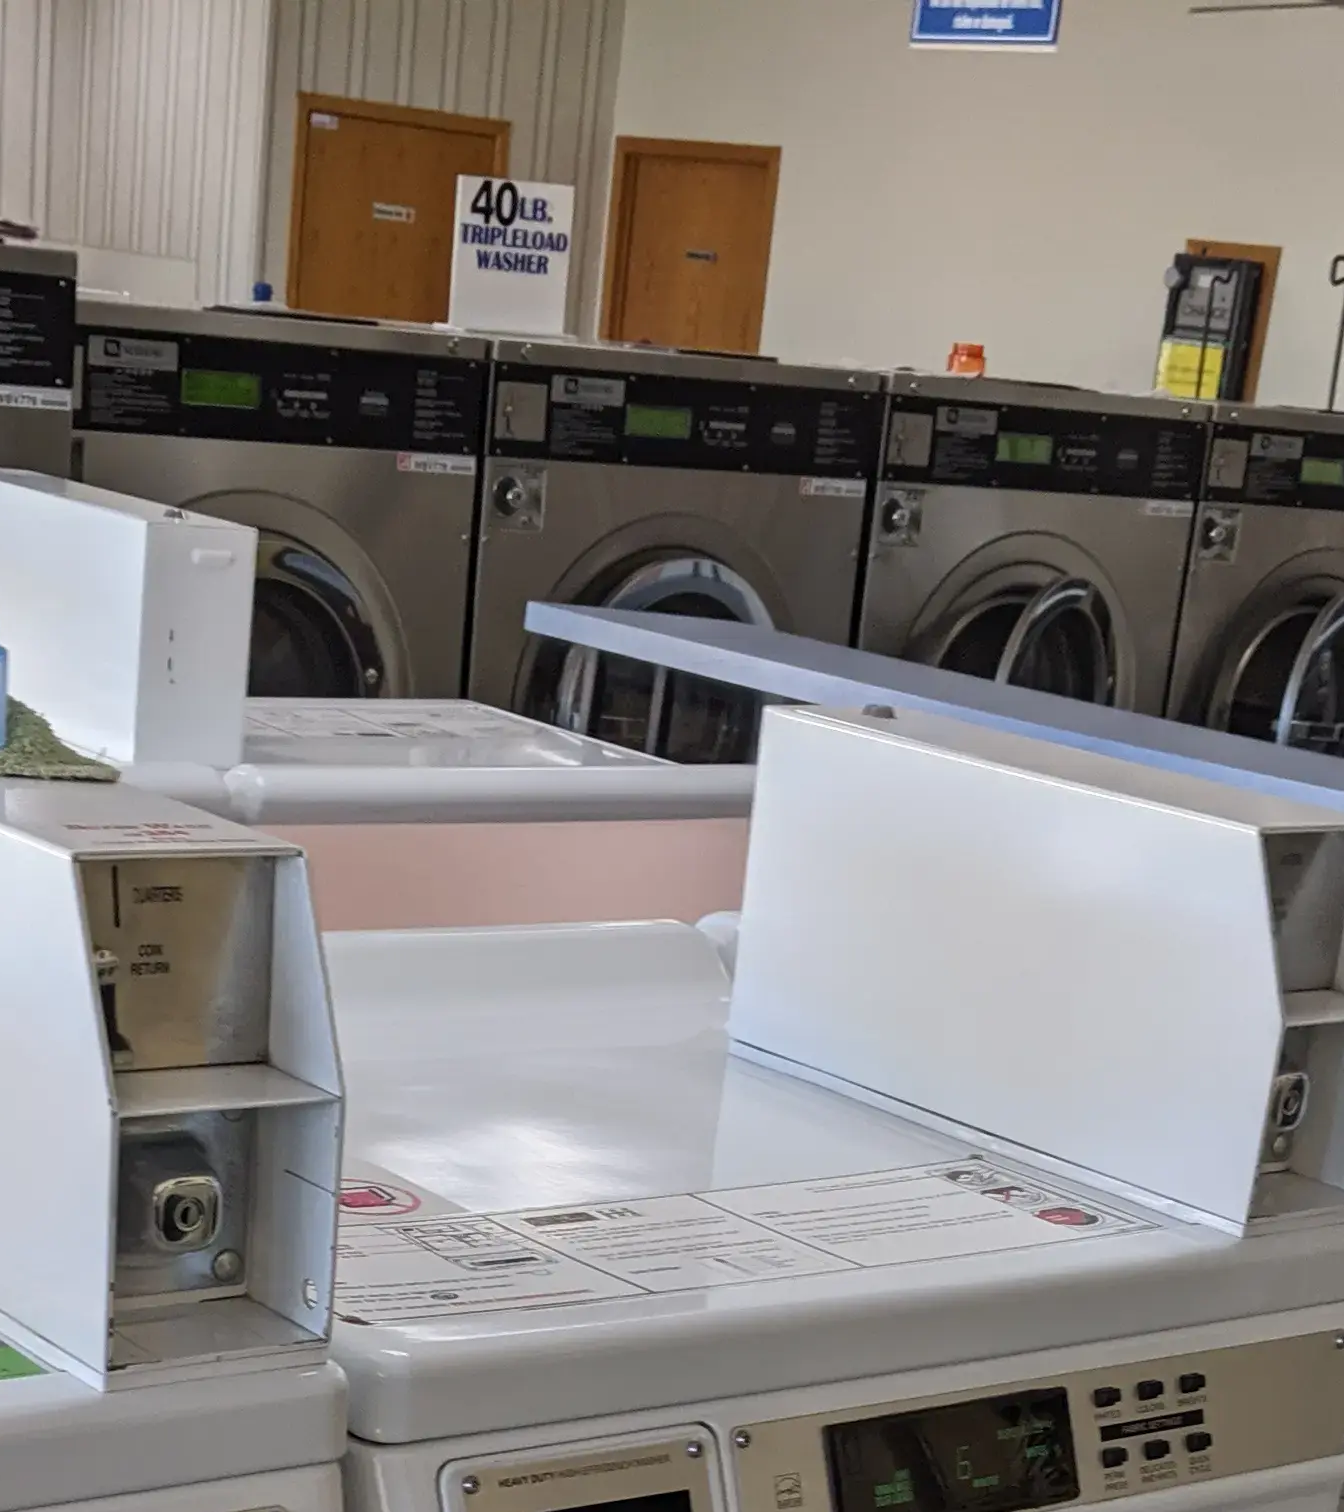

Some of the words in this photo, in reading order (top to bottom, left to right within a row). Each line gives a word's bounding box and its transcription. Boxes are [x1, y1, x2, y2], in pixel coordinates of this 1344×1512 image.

[471, 180, 519, 226] 40
[519, 197, 554, 223] LB.
[460, 222, 568, 252] TRIPLELOAD
[476, 249, 550, 274] WASHER
[130, 961, 171, 976] RETURN
